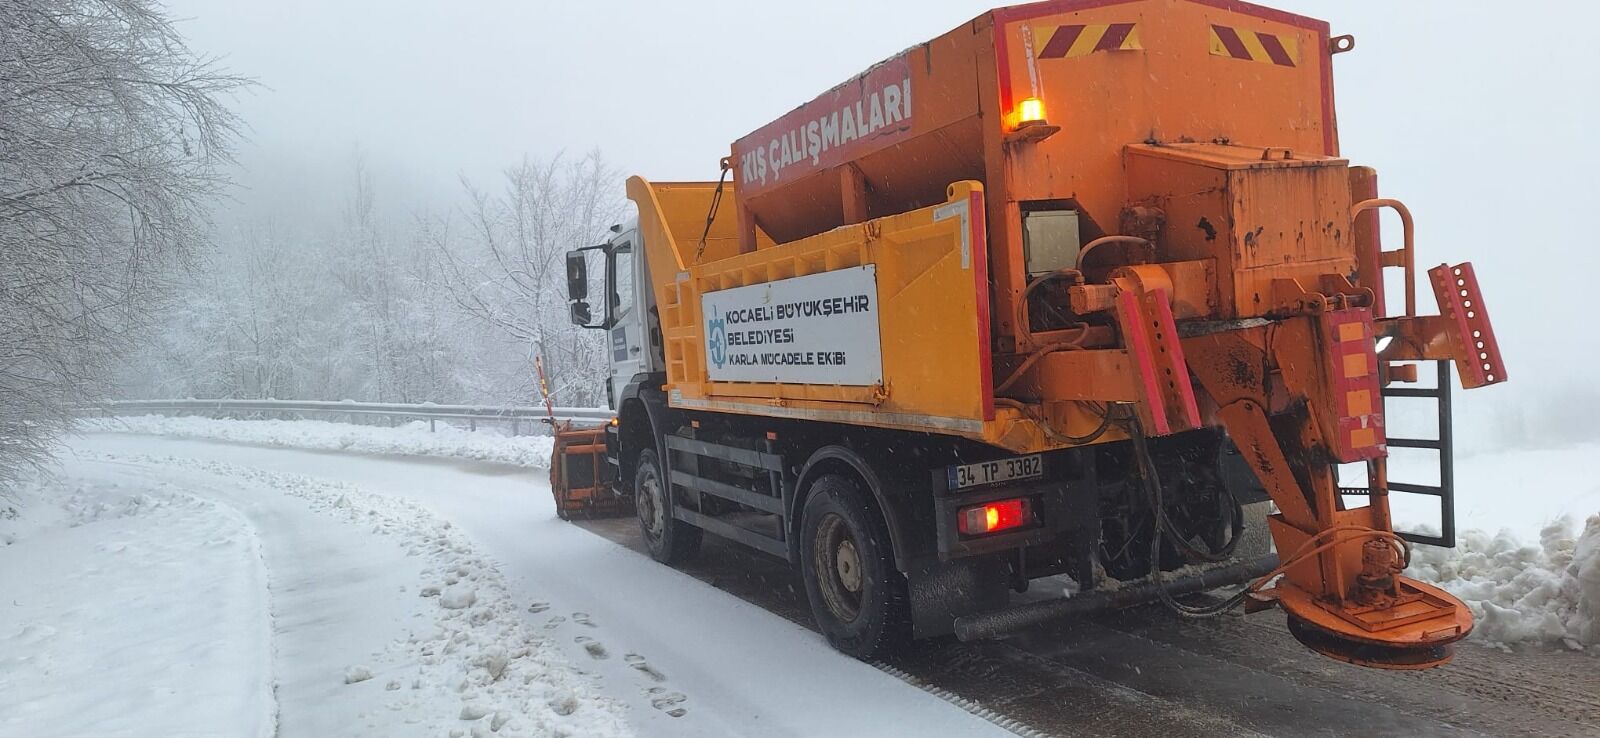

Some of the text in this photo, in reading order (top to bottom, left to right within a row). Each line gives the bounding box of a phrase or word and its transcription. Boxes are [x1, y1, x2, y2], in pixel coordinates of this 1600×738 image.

[742, 78, 912, 186] KIŞ ÇALIŞMALARI
[726, 295, 869, 324] KOCAELİ BÜYÜKŞEHİR
[728, 328, 794, 346] BELEDİYESİ
[729, 351, 846, 365] KARLA MÜCADELE EKİBİ
[958, 457, 1041, 486] 34 TP 3382
